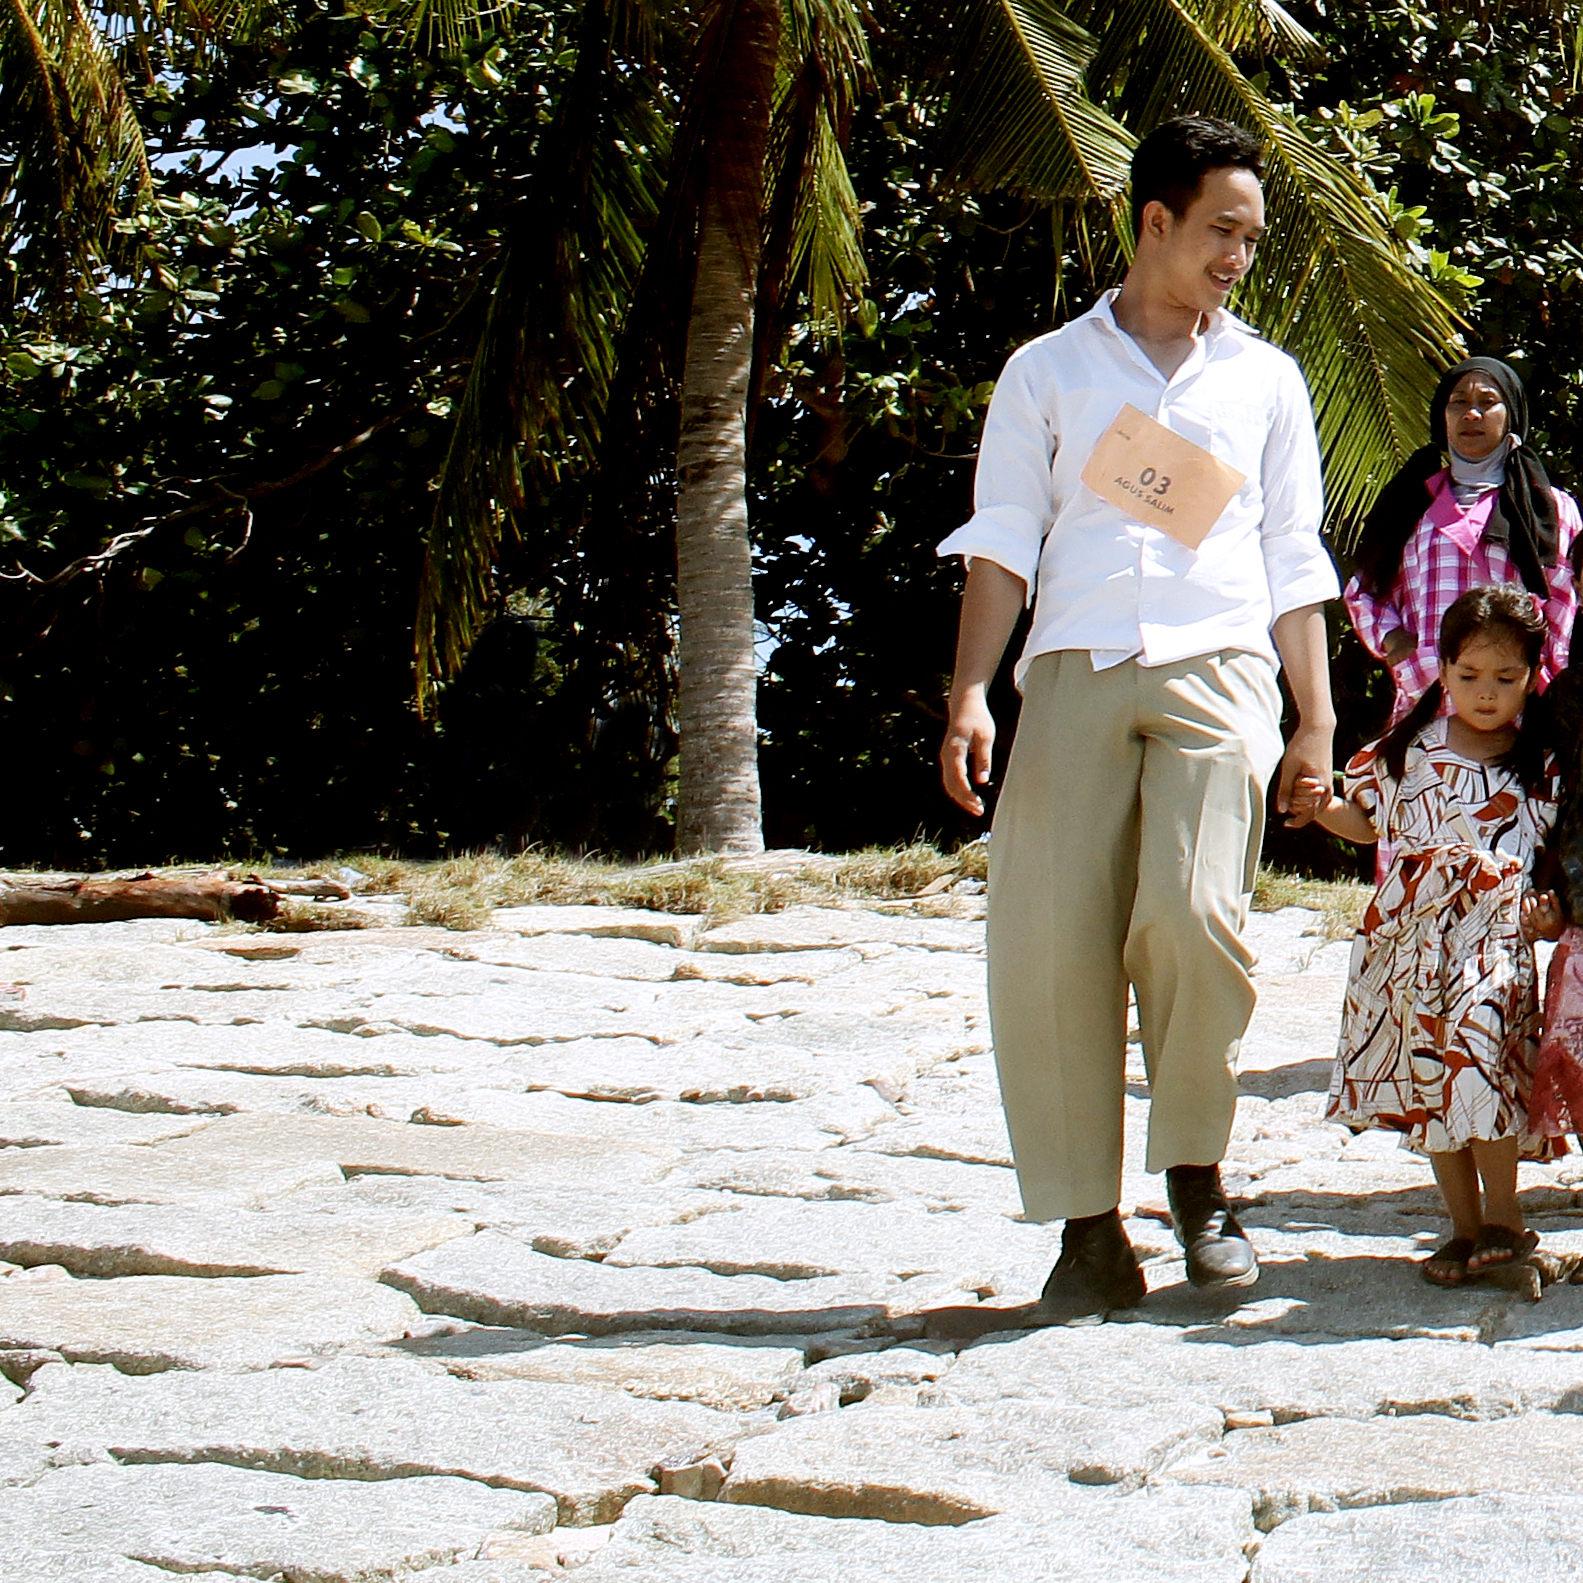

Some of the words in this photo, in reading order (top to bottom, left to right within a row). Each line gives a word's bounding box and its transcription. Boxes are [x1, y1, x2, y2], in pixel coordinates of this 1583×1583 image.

[1114, 476, 1144, 497] AGUS
[1144, 495, 1175, 514] SALIM
[1140, 467, 1171, 495] 03
